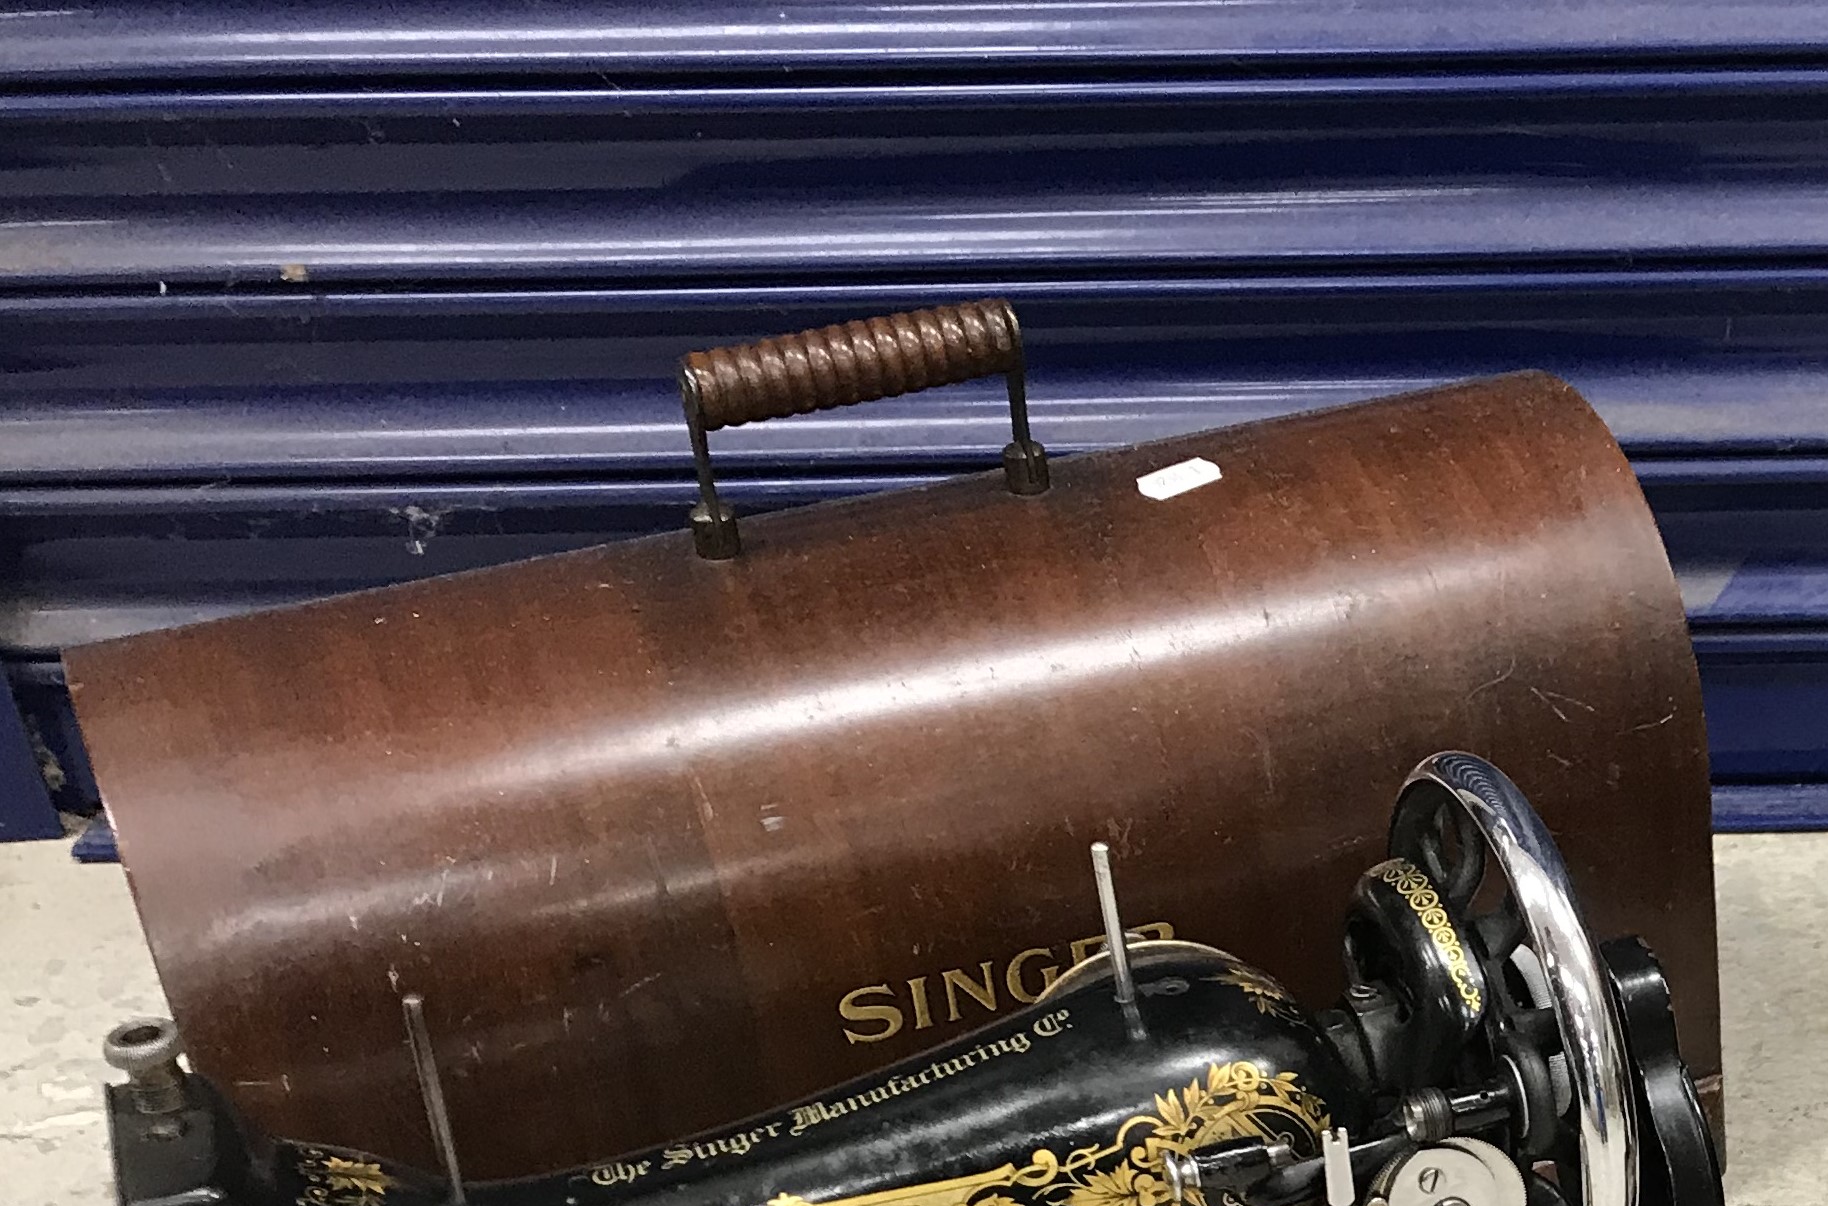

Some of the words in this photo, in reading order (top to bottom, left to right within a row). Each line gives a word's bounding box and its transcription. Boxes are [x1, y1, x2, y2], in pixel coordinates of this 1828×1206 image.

[591, 1156, 652, 1187] The
[660, 1121, 784, 1168] Singer
[789, 1030, 1030, 1138] Manufacturing
